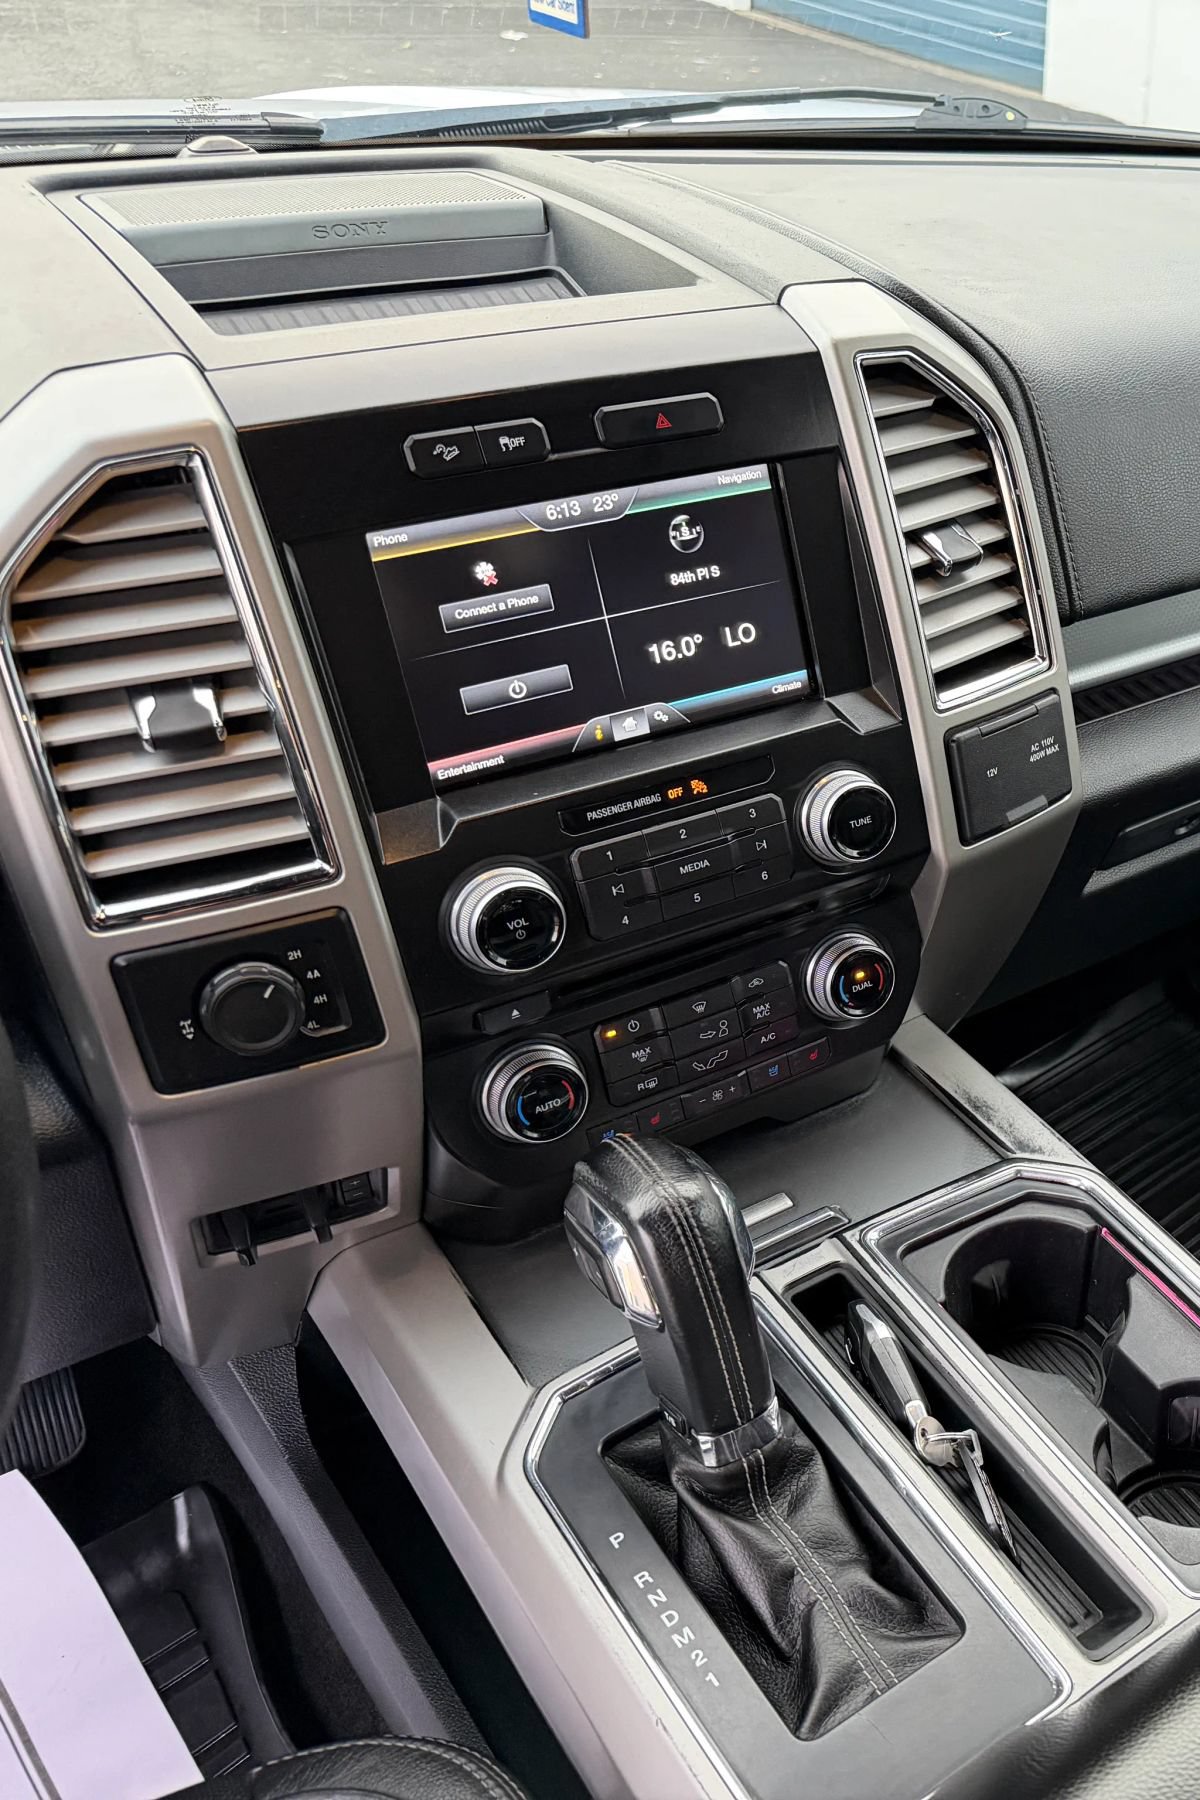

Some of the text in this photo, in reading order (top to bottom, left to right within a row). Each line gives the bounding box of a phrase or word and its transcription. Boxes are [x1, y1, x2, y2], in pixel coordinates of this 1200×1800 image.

[311, 221, 388, 239] SONY
[510, 436, 525, 448] OFF
[717, 469, 762, 485] Navigation
[546, 494, 619, 520] 6:13 23°
[373, 533, 408, 546] Phone
[670, 570, 697, 586] 84th
[710, 565, 720, 577] S
[455, 595, 539, 620] Connect a Phone
[648, 622, 756, 664] 16.0° LO
[772, 680, 802, 695] Climate
[1031, 736, 1055, 752] AC 110V
[1029, 744, 1060, 762] 400W MAX
[437, 755, 504, 780] Entertainment
[986, 767, 998, 777] 12V
[586, 787, 684, 822] PASSENGER AIRBAG OFF
[748, 808, 757, 819] 3
[850, 814, 873, 828] TUNE
[679, 829, 687, 839] 2
[605, 851, 614, 861] 1
[679, 859, 710, 874] MEDIA
[761, 870, 769, 881] 6
[693, 891, 701, 903] 5
[506, 917, 530, 931] VOL
[622, 914, 630, 926] 4
[287, 950, 302, 960] 2H
[306, 969, 321, 980] 4A
[852, 981, 873, 993] DUAL
[313, 994, 327, 1005] 4H
[753, 1002, 771, 1014] MAX
[756, 1009, 771, 1020] A/C
[307, 1020, 320, 1029] 4L
[760, 1032, 777, 1044] A/C
[631, 1046, 652, 1059] MAX
[637, 1083, 645, 1092] R
[535, 1098, 561, 1114] AUTO
[608, 1531, 625, 1549] P
[633, 1570, 654, 1589] R
[647, 1588, 668, 1608] N
[660, 1609, 680, 1628] D
[671, 1626, 696, 1649] M
[690, 1649, 708, 1668] 2
[705, 1671, 720, 1688] 1
